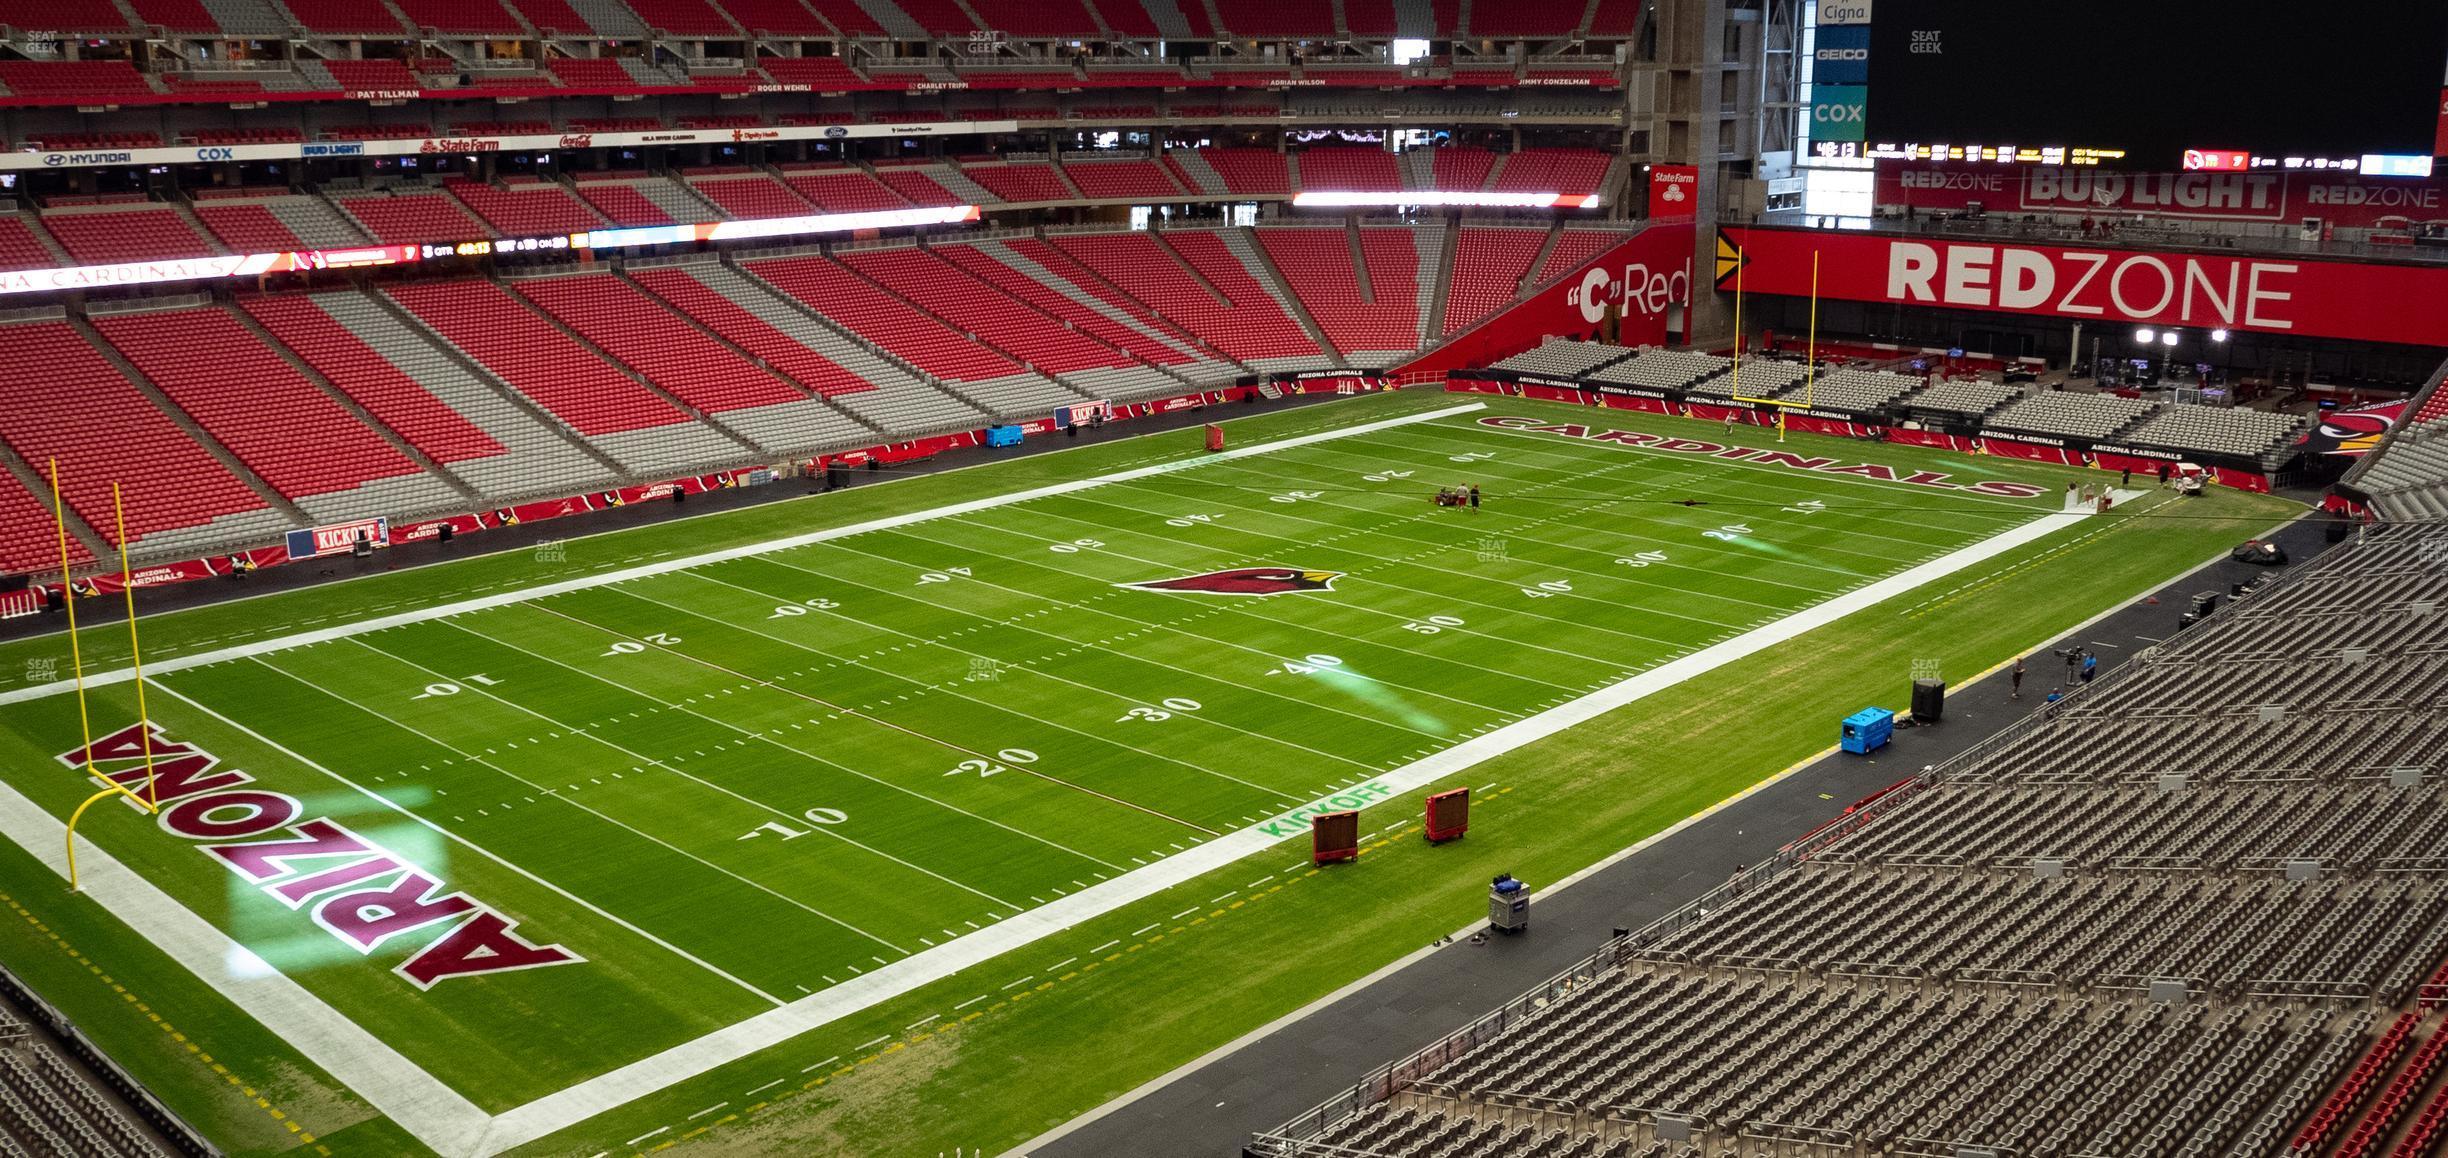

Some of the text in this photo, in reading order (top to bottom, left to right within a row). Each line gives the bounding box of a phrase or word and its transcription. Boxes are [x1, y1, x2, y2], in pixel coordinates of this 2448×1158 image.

[1824, 5, 1865, 22] Cigna
[1817, 49, 1868, 60] GEICO
[378, 90, 420, 98] TILLMAN
[1815, 104, 1863, 122] COX
[198, 148, 232, 160] COX
[303, 144, 362, 155] BUD LIGHT
[69, 153, 131, 164] HYUNDAI
[2031, 167, 2277, 209] BUD LIGHT
[51, 260, 224, 286] CARDINALS
[1297, 369, 1363, 379] ARIZONA CARDINALS
[1518, 376, 1580, 389] ARIZONA CARDINALS
[1599, 386, 1665, 399] ARIZONA CARDINALS
[1685, 396, 1755, 409] ARIZONA CARDINALS
[1777, 406, 1851, 420] ARIZONA CARDINALS
[1979, 430, 2064, 446] ARIZONA CARDINALS
[1476, 416, 2052, 498] CARDINALS
[2091, 444, 2182, 461] ARIZONA CARDINALS
[1782, 500, 1826, 515] 10
[1166, 512, 1212, 528] 40
[1702, 523, 1750, 542] 20
[1049, 537, 1106, 554] 50
[1615, 551, 1668, 568] 30
[134, 568, 171, 583] ARIZONA
[921, 566, 973, 583] 40
[1521, 580, 1573, 598] 40
[773, 597, 841, 618] 30
[1402, 616, 1464, 635] 50
[610, 632, 682, 655] 20
[1282, 654, 1342, 676] 40
[424, 673, 505, 697] 10
[1129, 698, 1202, 723] 30
[960, 748, 1040, 778] 20
[757, 807, 849, 842] 10
[54, 719, 588, 992] ARIZONA
